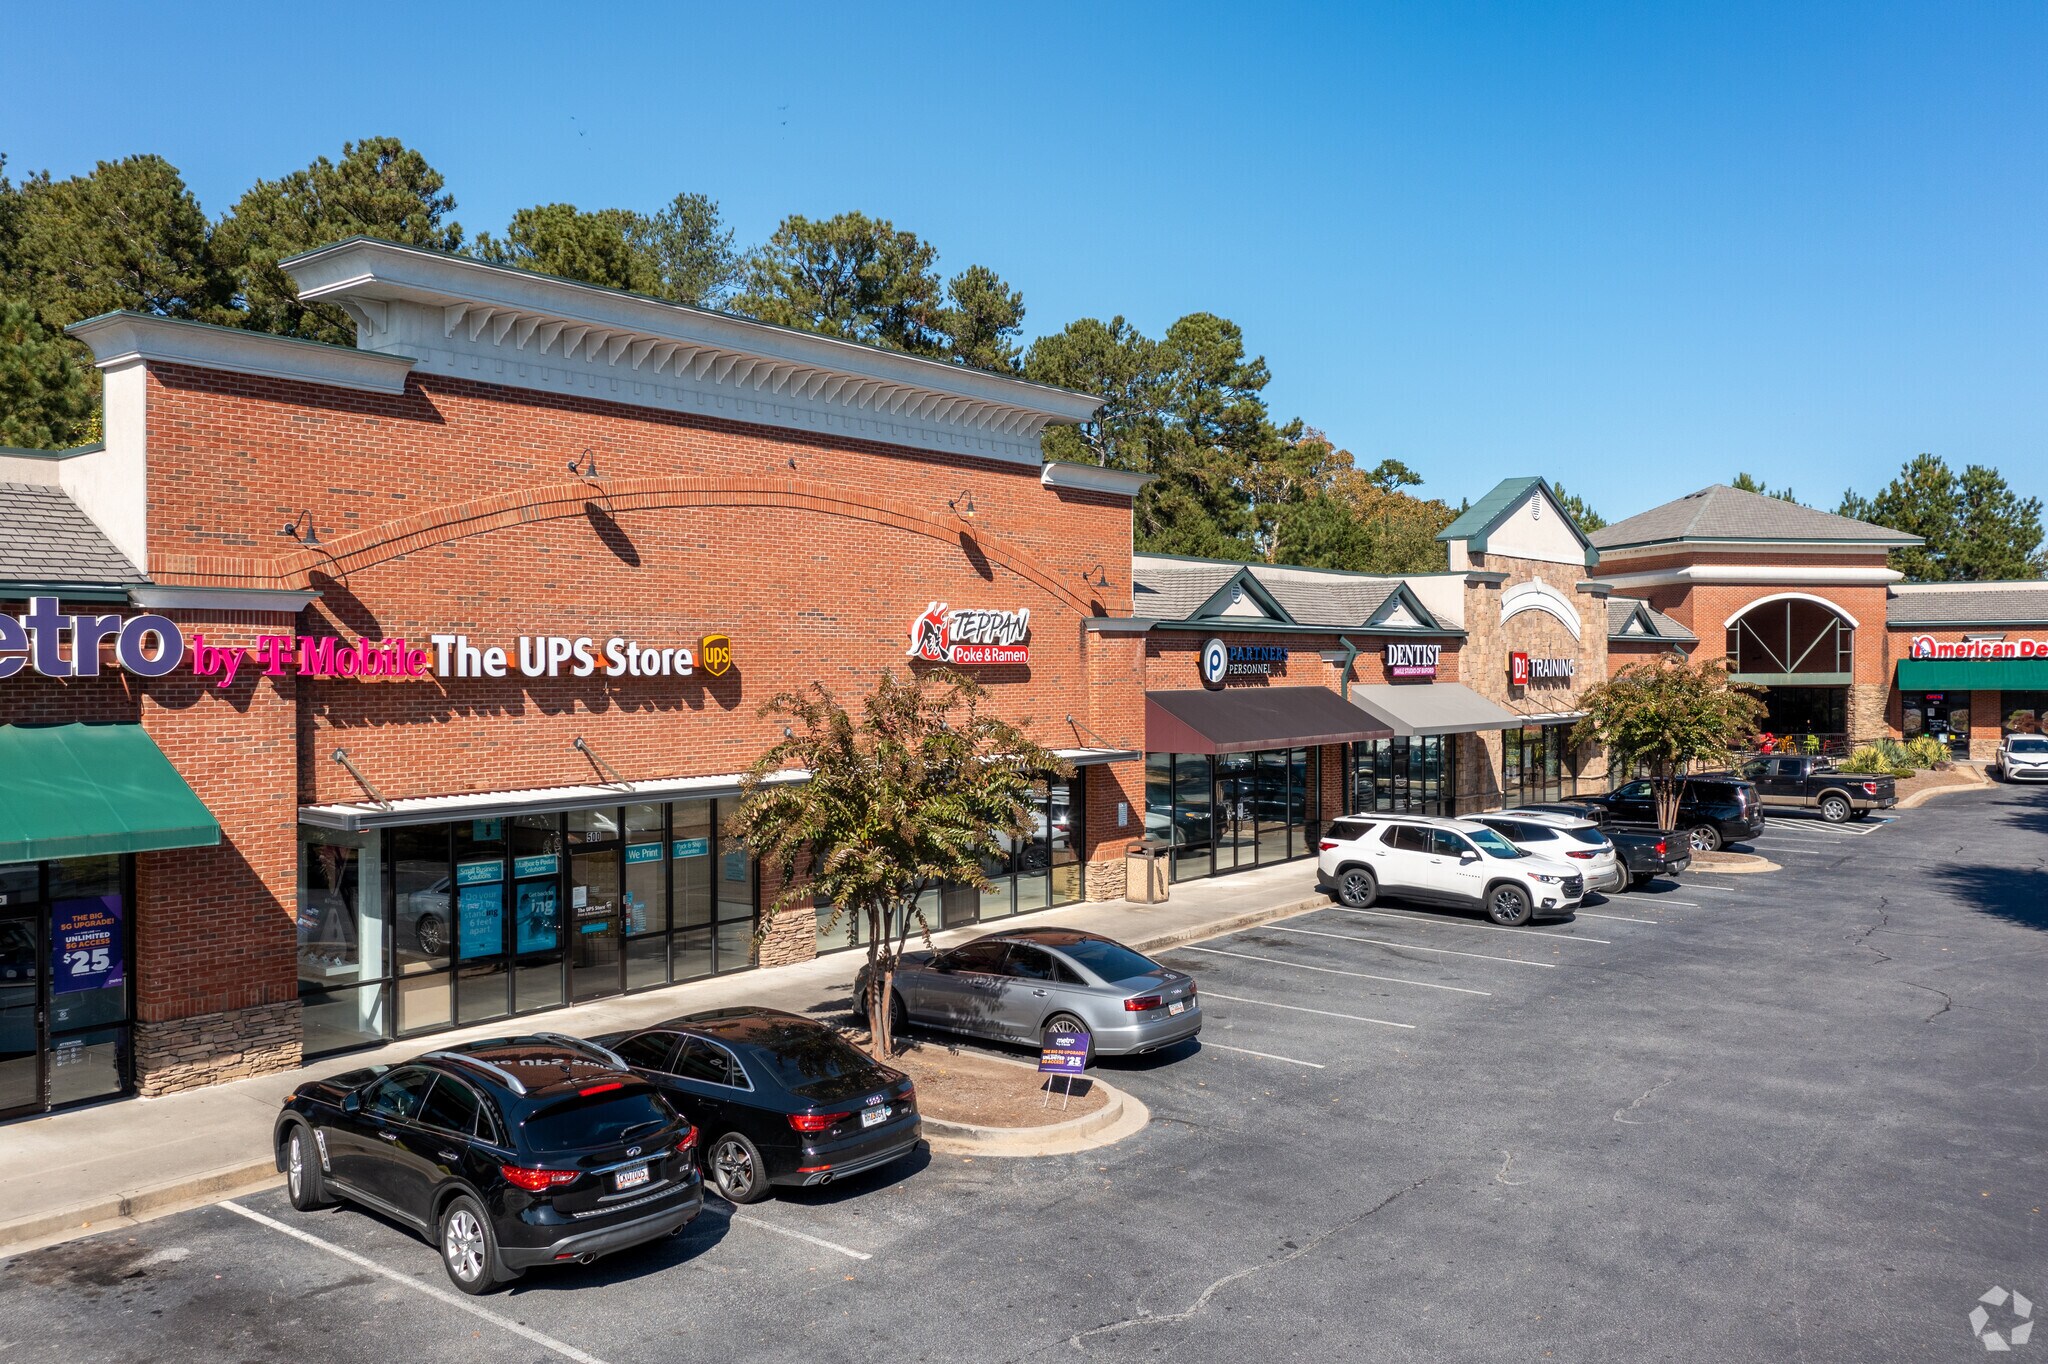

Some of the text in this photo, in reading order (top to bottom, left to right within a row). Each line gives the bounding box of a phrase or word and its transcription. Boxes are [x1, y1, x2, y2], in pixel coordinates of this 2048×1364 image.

[954, 610, 1028, 643] TEPPAN
[1914, 636, 2015, 657] American
[431, 635, 693, 677] The UPS Store
[705, 647, 729, 669] ups
[956, 647, 1026, 662] Poké & Ramen
[1230, 646, 1288, 661] PARTNERS
[1387, 645, 1441, 665] DENTIST
[190, 635, 246, 687] by
[1229, 664, 1271, 674] PERSONNEL
[1531, 659, 1574, 677] TRAINING
[586, 832, 601, 842] 500
[629, 848, 658, 859] We Print
[460, 865, 498, 875] Small Business
[525, 865, 546, 873] Solutions
[481, 891, 496, 901] your
[486, 900, 496, 909] by
[531, 899, 553, 915] ing
[72, 912, 103, 922] THE BIG
[465, 909, 498, 918] standing
[74, 918, 115, 929] UPGRADE!
[470, 917, 491, 927] 6 feet
[66, 932, 110, 942] UNLIMITED
[79, 938, 110, 947] ACCESS
[63, 947, 110, 975] $25
